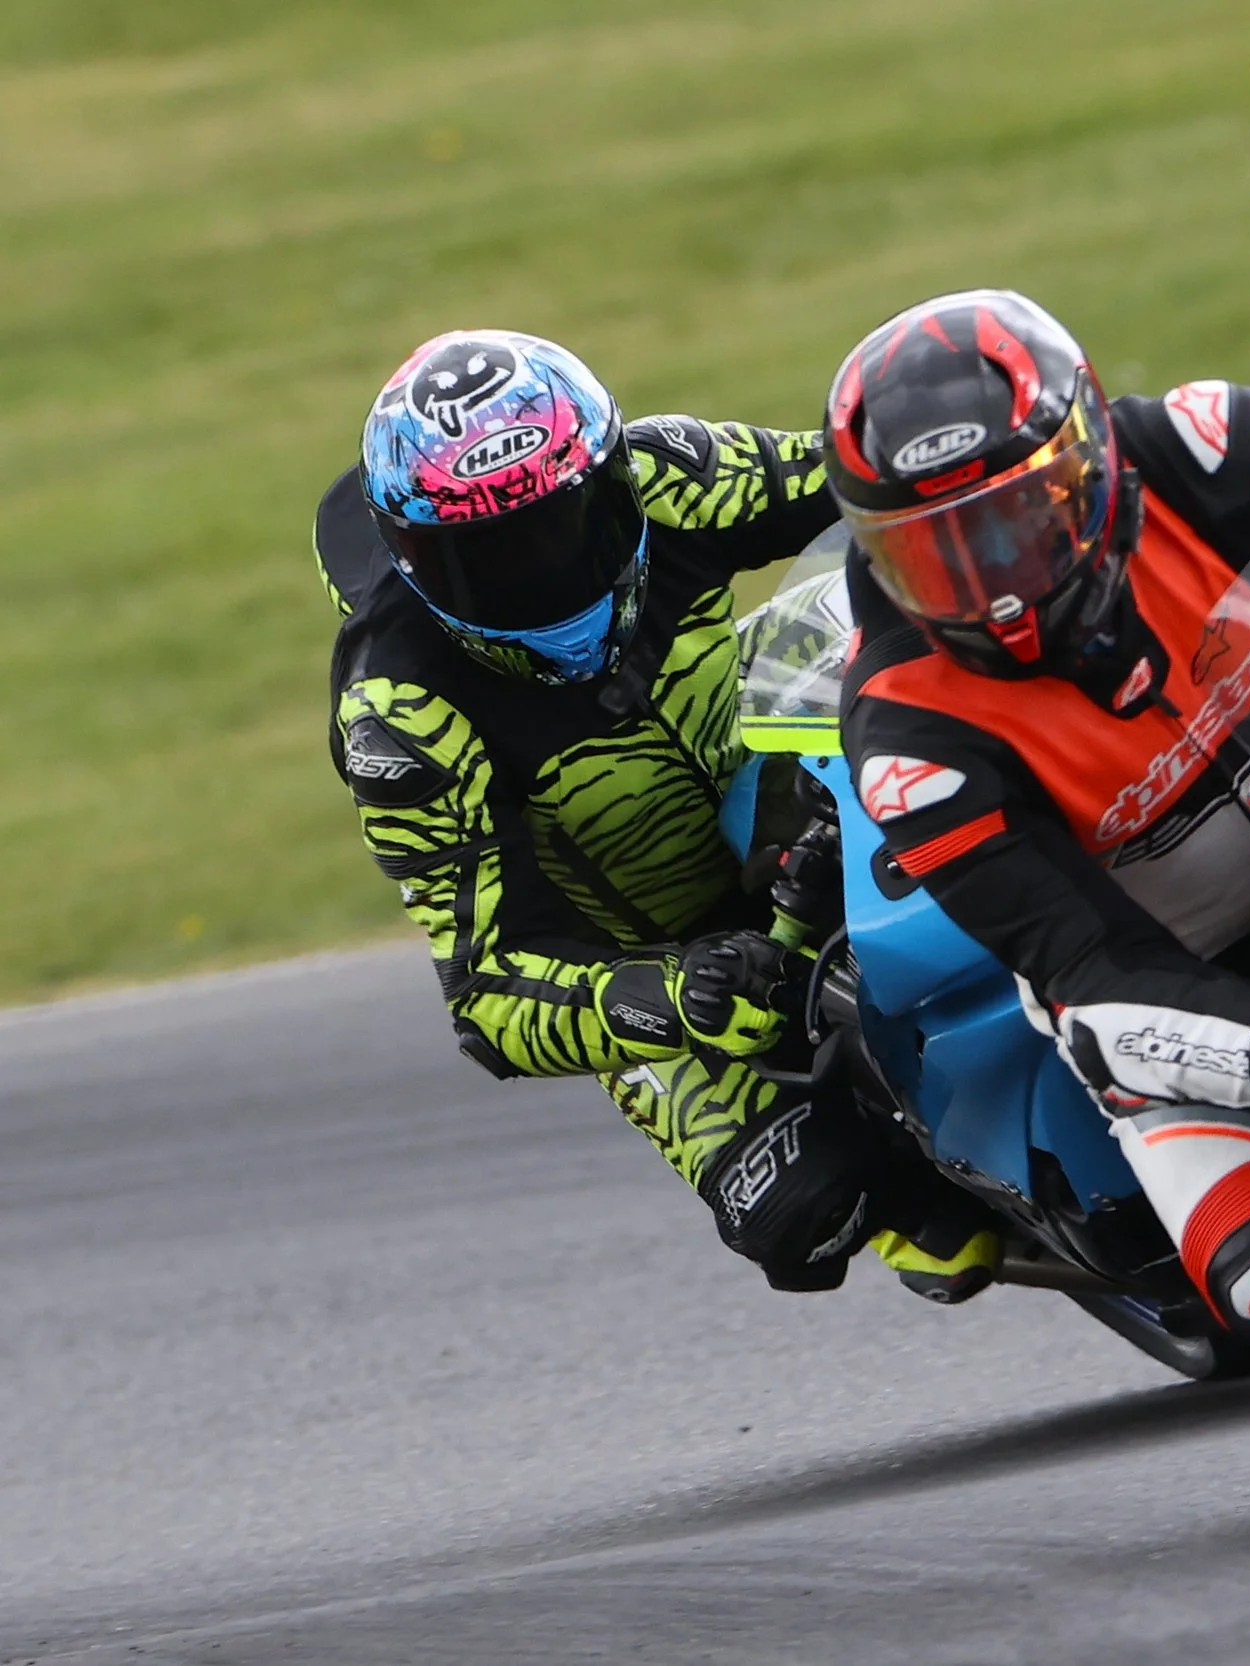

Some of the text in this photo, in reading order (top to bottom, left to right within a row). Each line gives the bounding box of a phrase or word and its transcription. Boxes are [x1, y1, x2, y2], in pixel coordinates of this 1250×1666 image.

[466, 428, 535, 473] HJC
[903, 429, 973, 465] HJC
[346, 751, 423, 781] RST
[609, 1003, 668, 1029] RST
